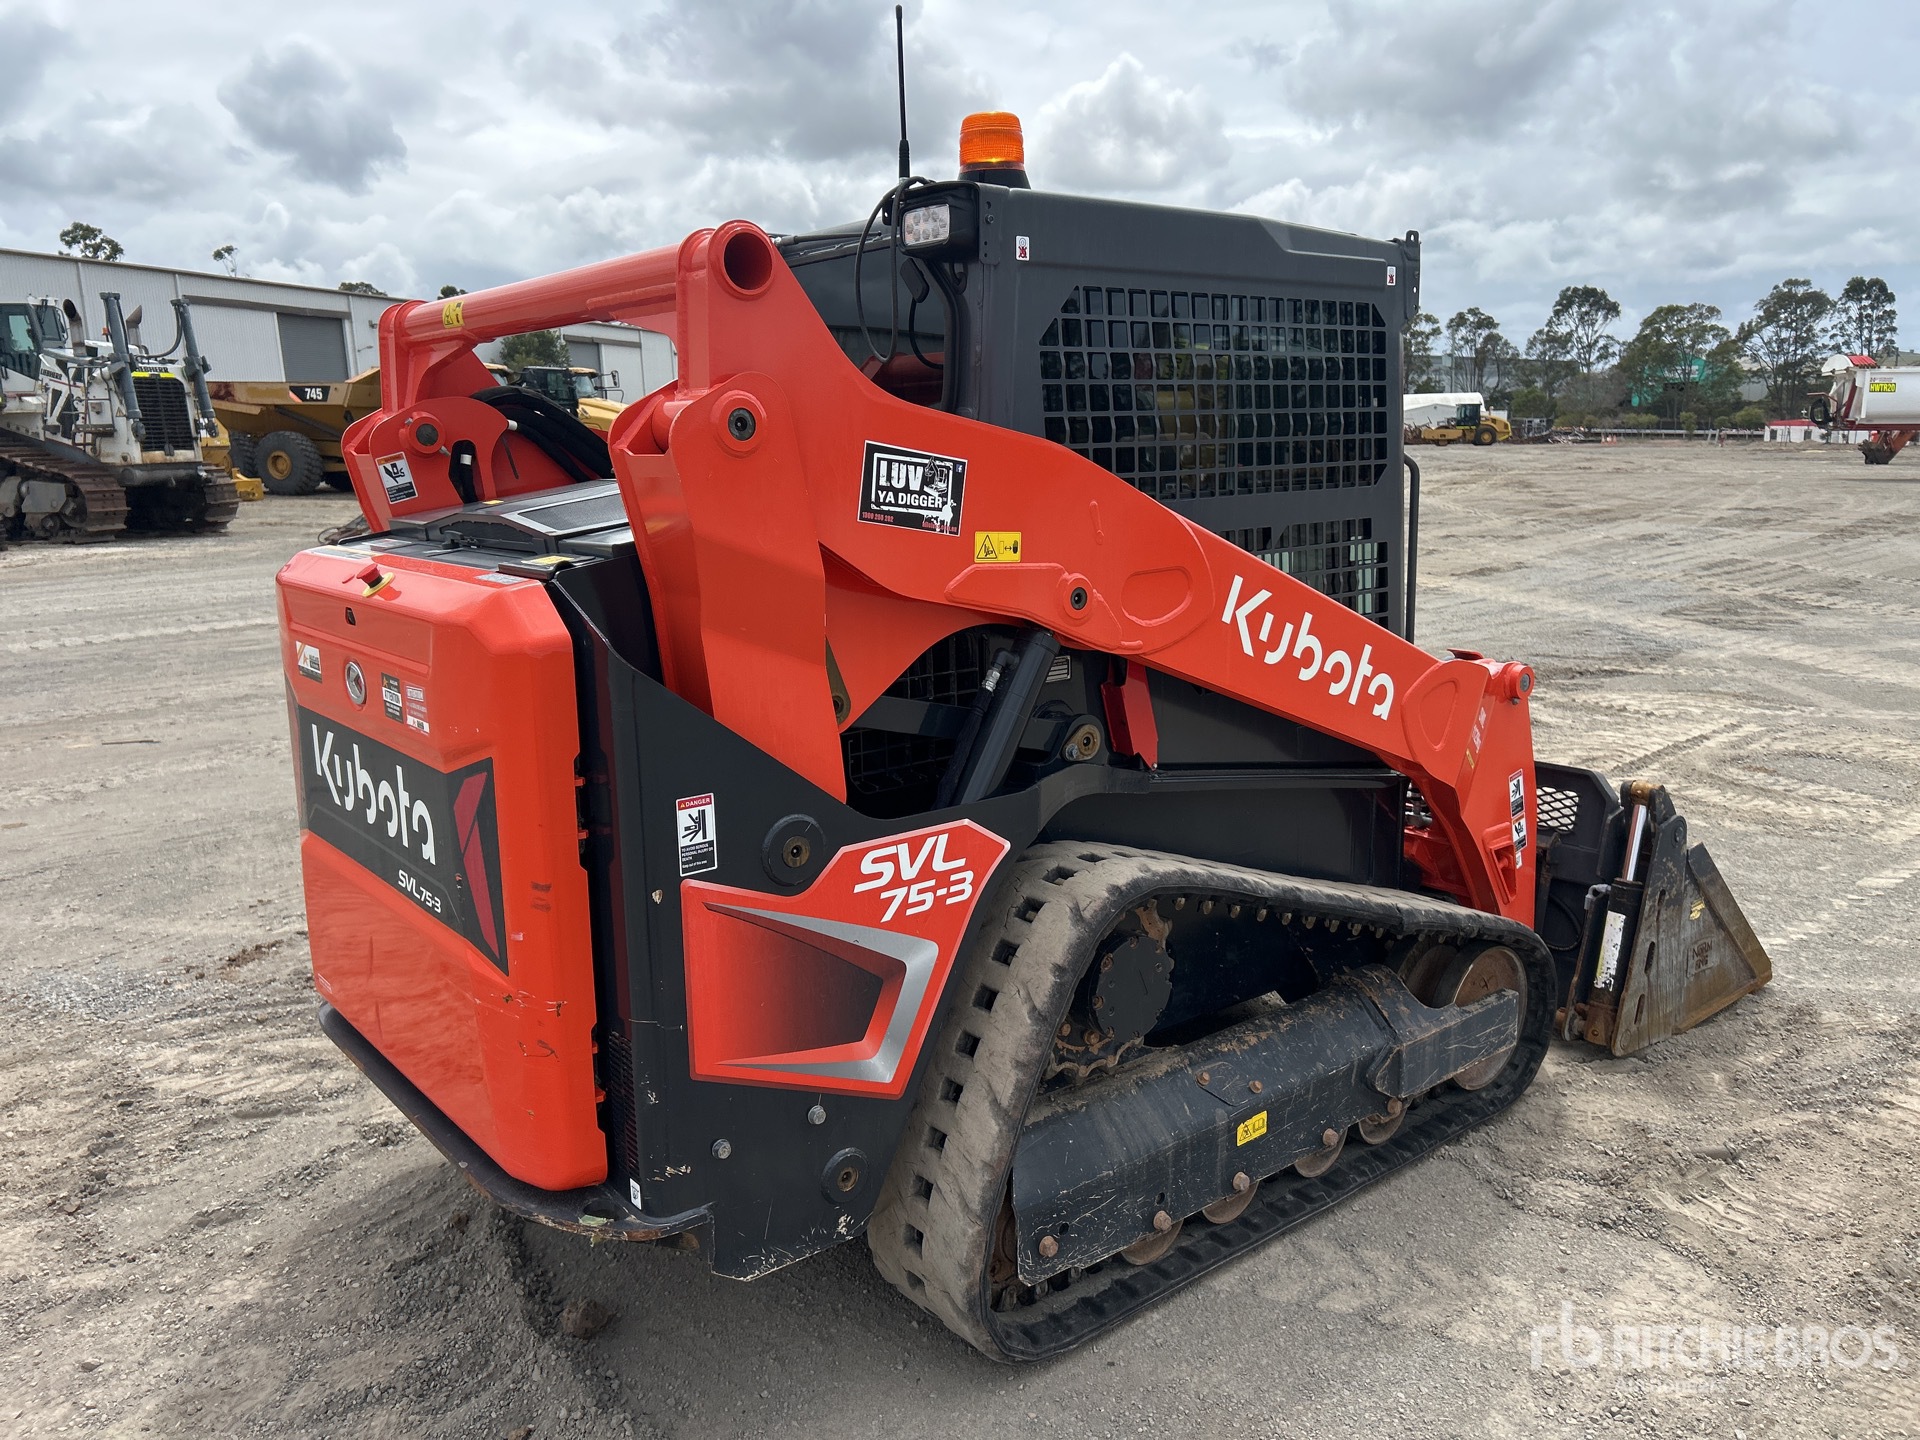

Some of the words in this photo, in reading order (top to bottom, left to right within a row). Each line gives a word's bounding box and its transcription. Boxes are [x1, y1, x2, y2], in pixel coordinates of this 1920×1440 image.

[304, 387, 323, 400] 745
[1870, 383, 1896, 392] HWTR20
[879, 460, 924, 491] LUV
[878, 490, 896, 504] YA
[897, 492, 943, 509] DIGGER
[1221, 574, 1395, 721] Kubota
[312, 723, 436, 865] Kubota
[685, 797, 710, 807] DANGER
[853, 833, 966, 894] SVL
[398, 869, 442, 914] SVL75-3
[879, 870, 975, 923] 75-3
